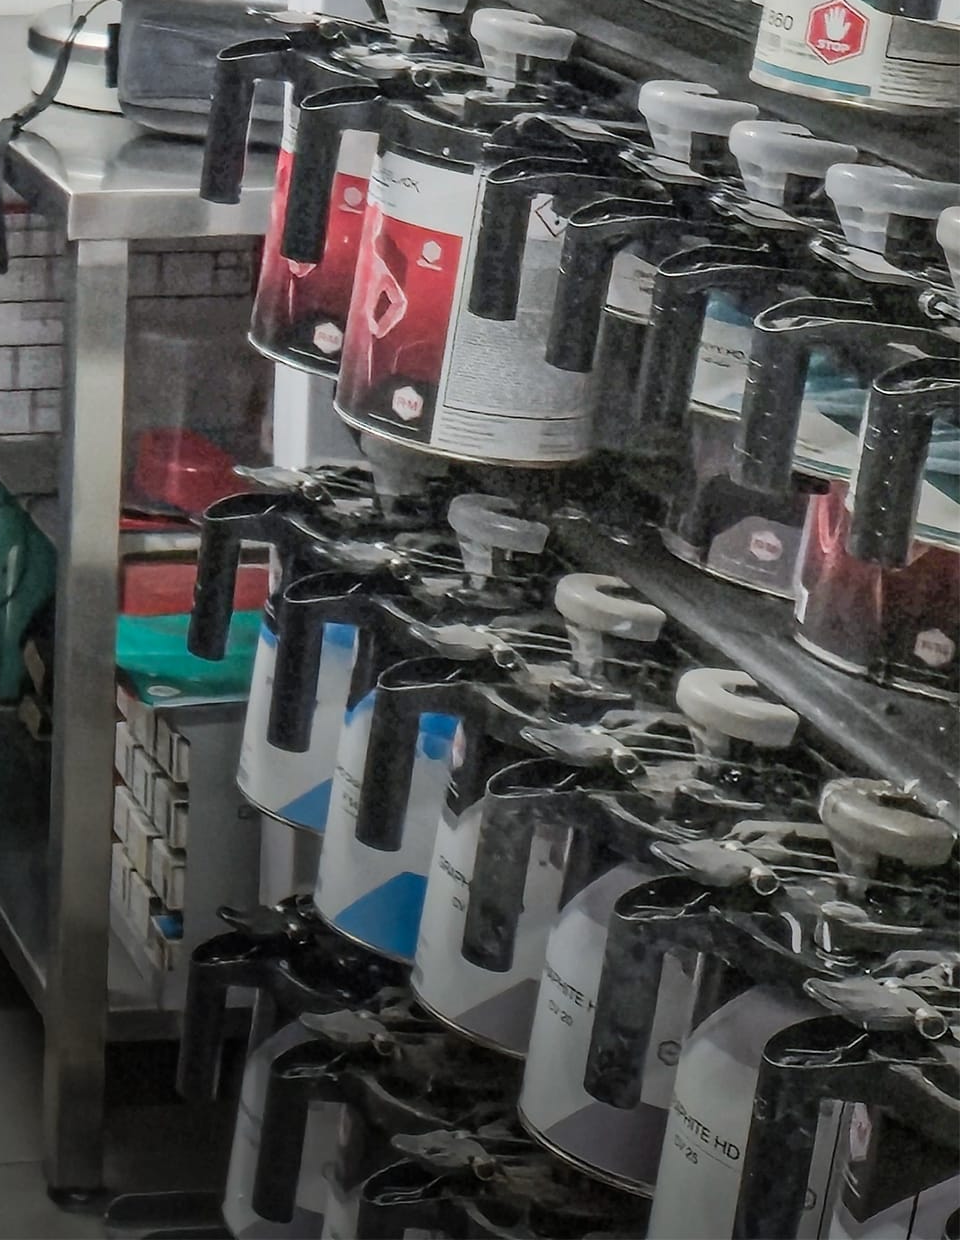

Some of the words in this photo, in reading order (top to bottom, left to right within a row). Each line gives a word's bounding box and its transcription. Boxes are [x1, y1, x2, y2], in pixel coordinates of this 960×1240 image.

[816, 39, 851, 54] STOP
[685, 1146, 699, 1165] 25
[713, 1135, 741, 1161] HD
